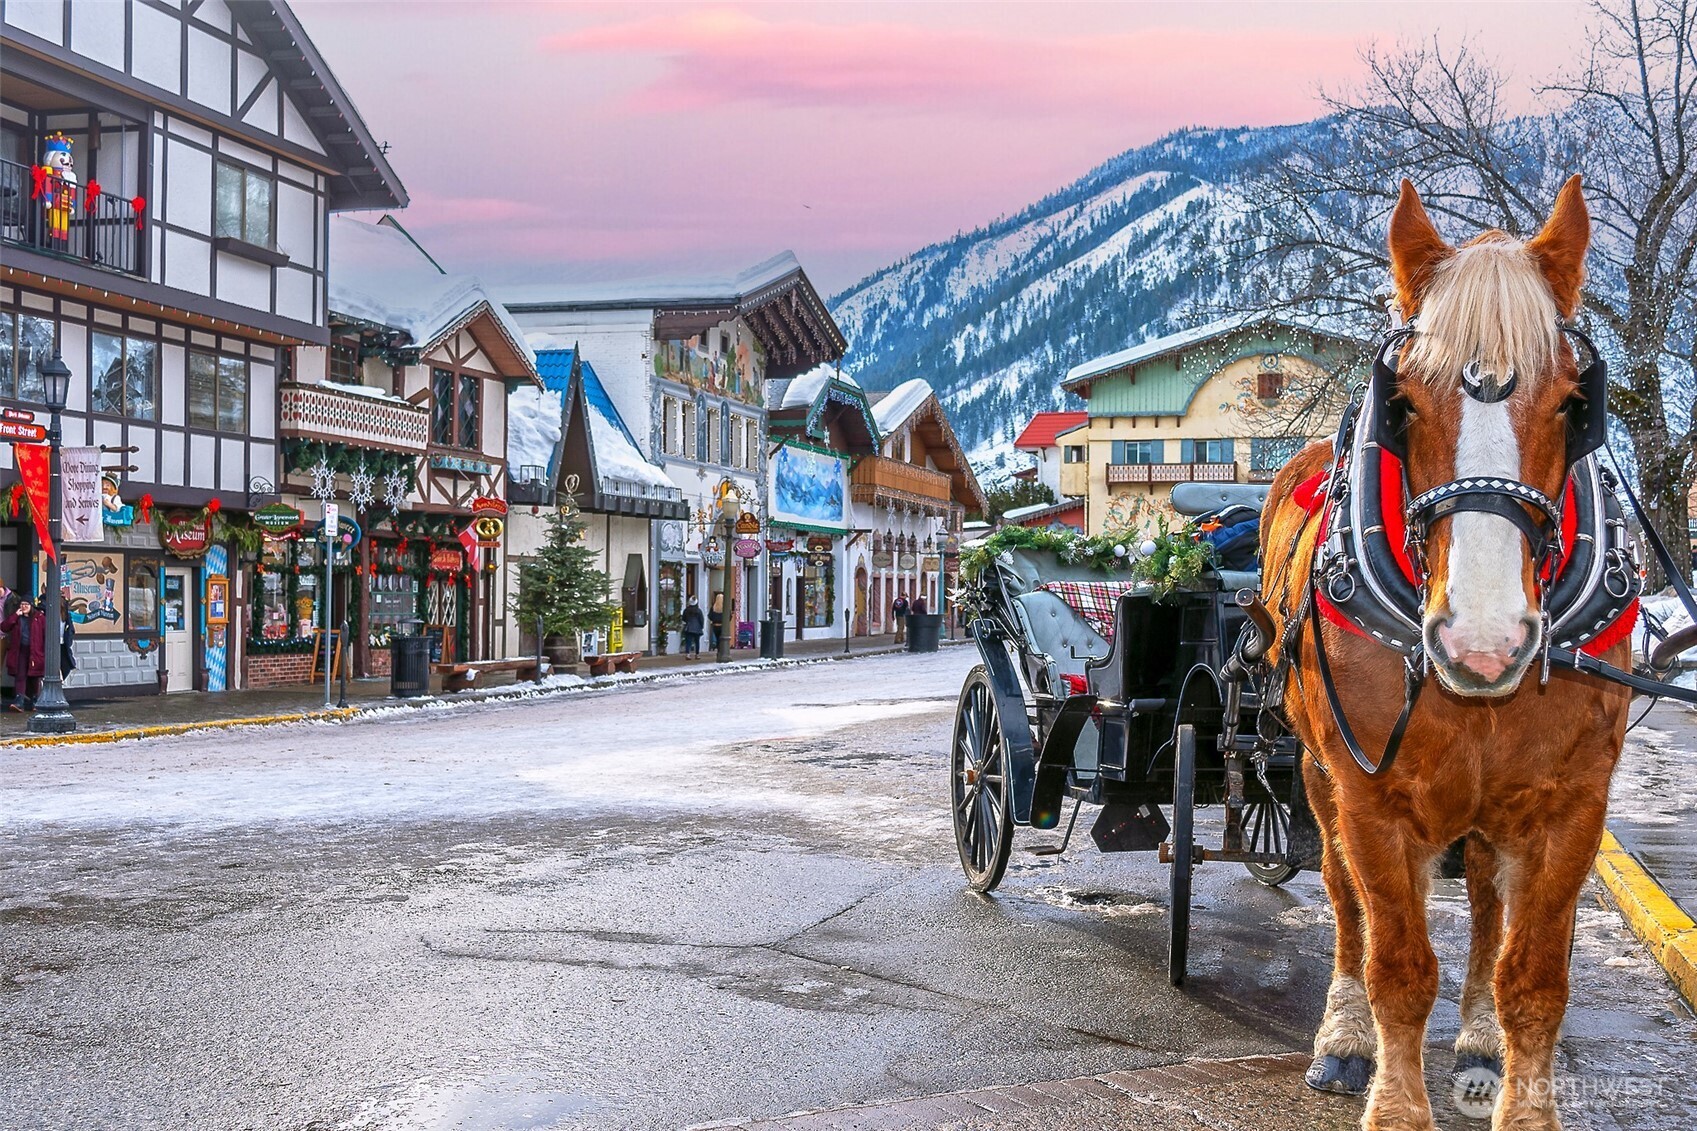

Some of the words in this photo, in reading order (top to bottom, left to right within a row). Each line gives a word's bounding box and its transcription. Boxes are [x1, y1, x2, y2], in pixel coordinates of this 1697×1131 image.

[0, 422, 17, 435] Front
[18, 425, 37, 438] Street
[63, 461, 79, 474] More
[67, 478, 96, 493] Shopping
[65, 497, 77, 509] and
[78, 496, 99, 509] Services
